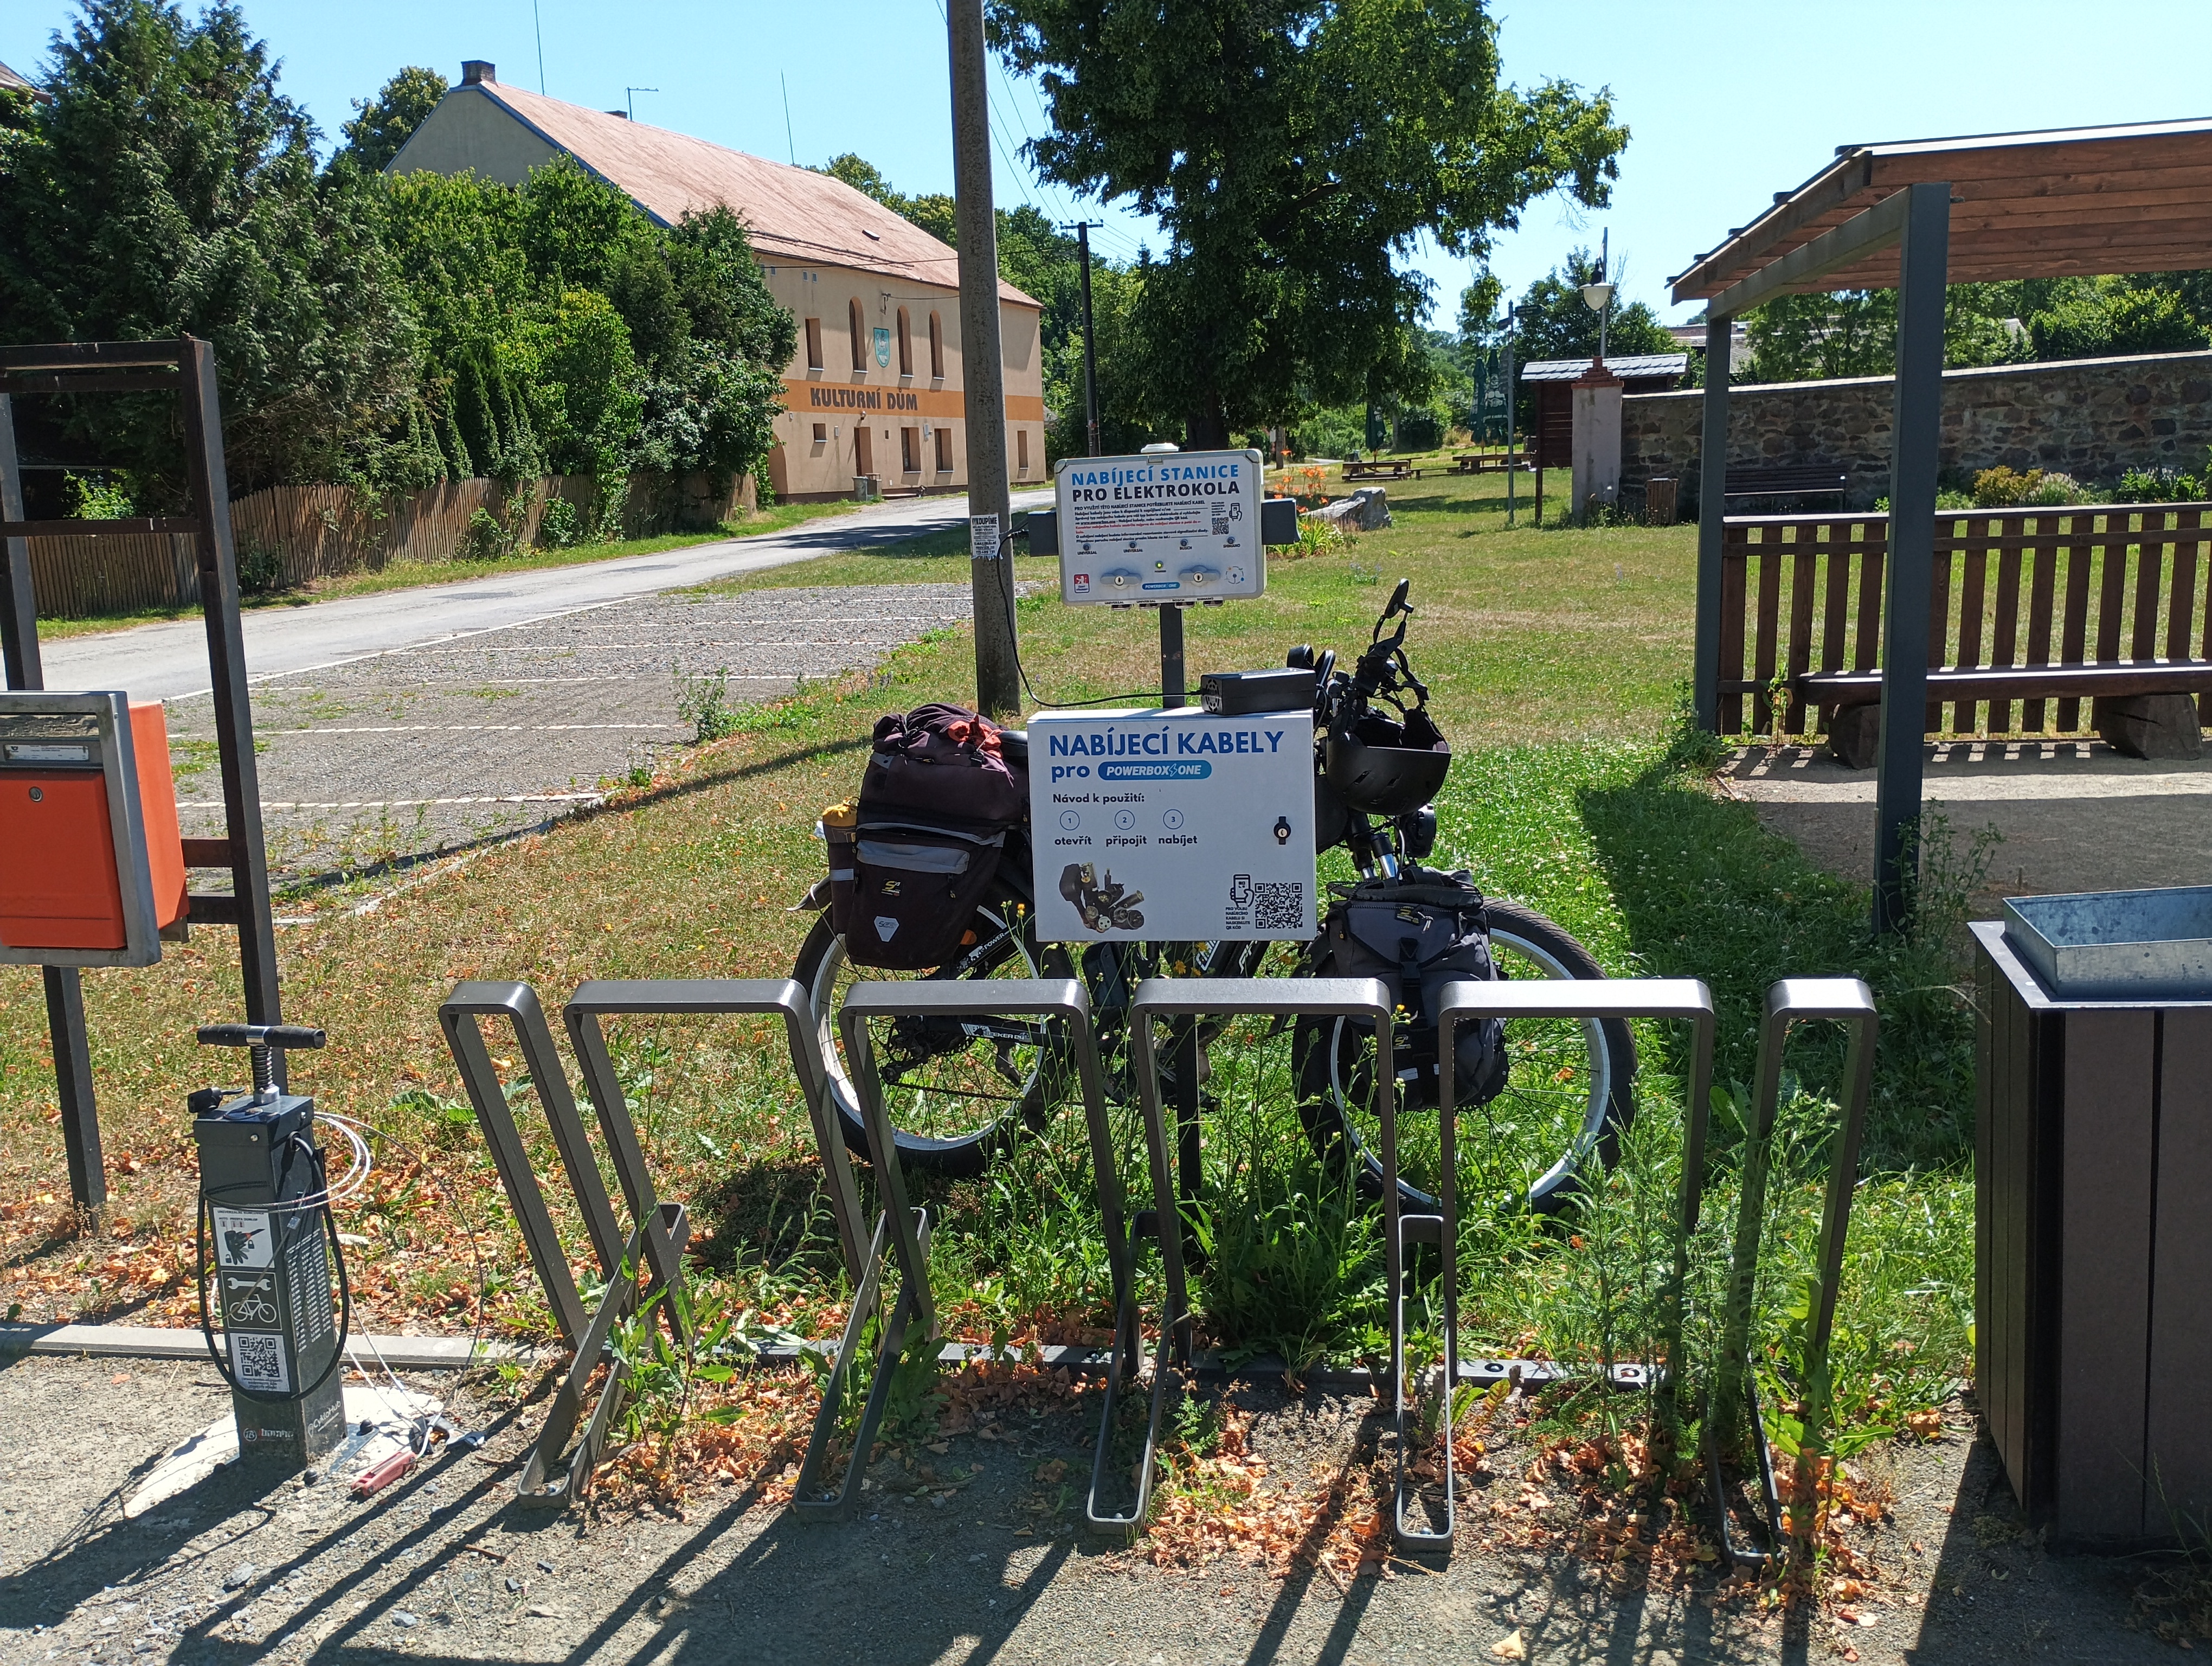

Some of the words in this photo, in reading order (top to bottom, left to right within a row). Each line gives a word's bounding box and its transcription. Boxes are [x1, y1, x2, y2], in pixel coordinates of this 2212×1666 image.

[810, 387, 882, 409] KULTURNÍ
[887, 388, 918, 411] DŮM
[1071, 465, 1154, 487] NABÍJECÍ
[1160, 464, 1239, 481] STANICE
[1072, 488, 1108, 502] PRO
[1114, 480, 1240, 501] ELEKTROKOLA
[1049, 726, 1169, 756] NABÍJECÍ
[1178, 731, 1284, 754] KABELY
[1051, 764, 1091, 783] pro
[1106, 765, 1169, 777] POWERBOX
[1178, 765, 1202, 776] ONE
[1053, 792, 1090, 804] Návod
[1092, 793, 1100, 803] k
[1103, 792, 1145, 805] použití:
[1054, 835, 1092, 846] otevřít
[1105, 835, 1147, 847] připojit
[1158, 835, 1198, 847] nabíjet
[984, 933, 1005, 950] POWER
[983, 1031, 1013, 1040] SEEKER
[313, 1400, 341, 1428] CykloHub
